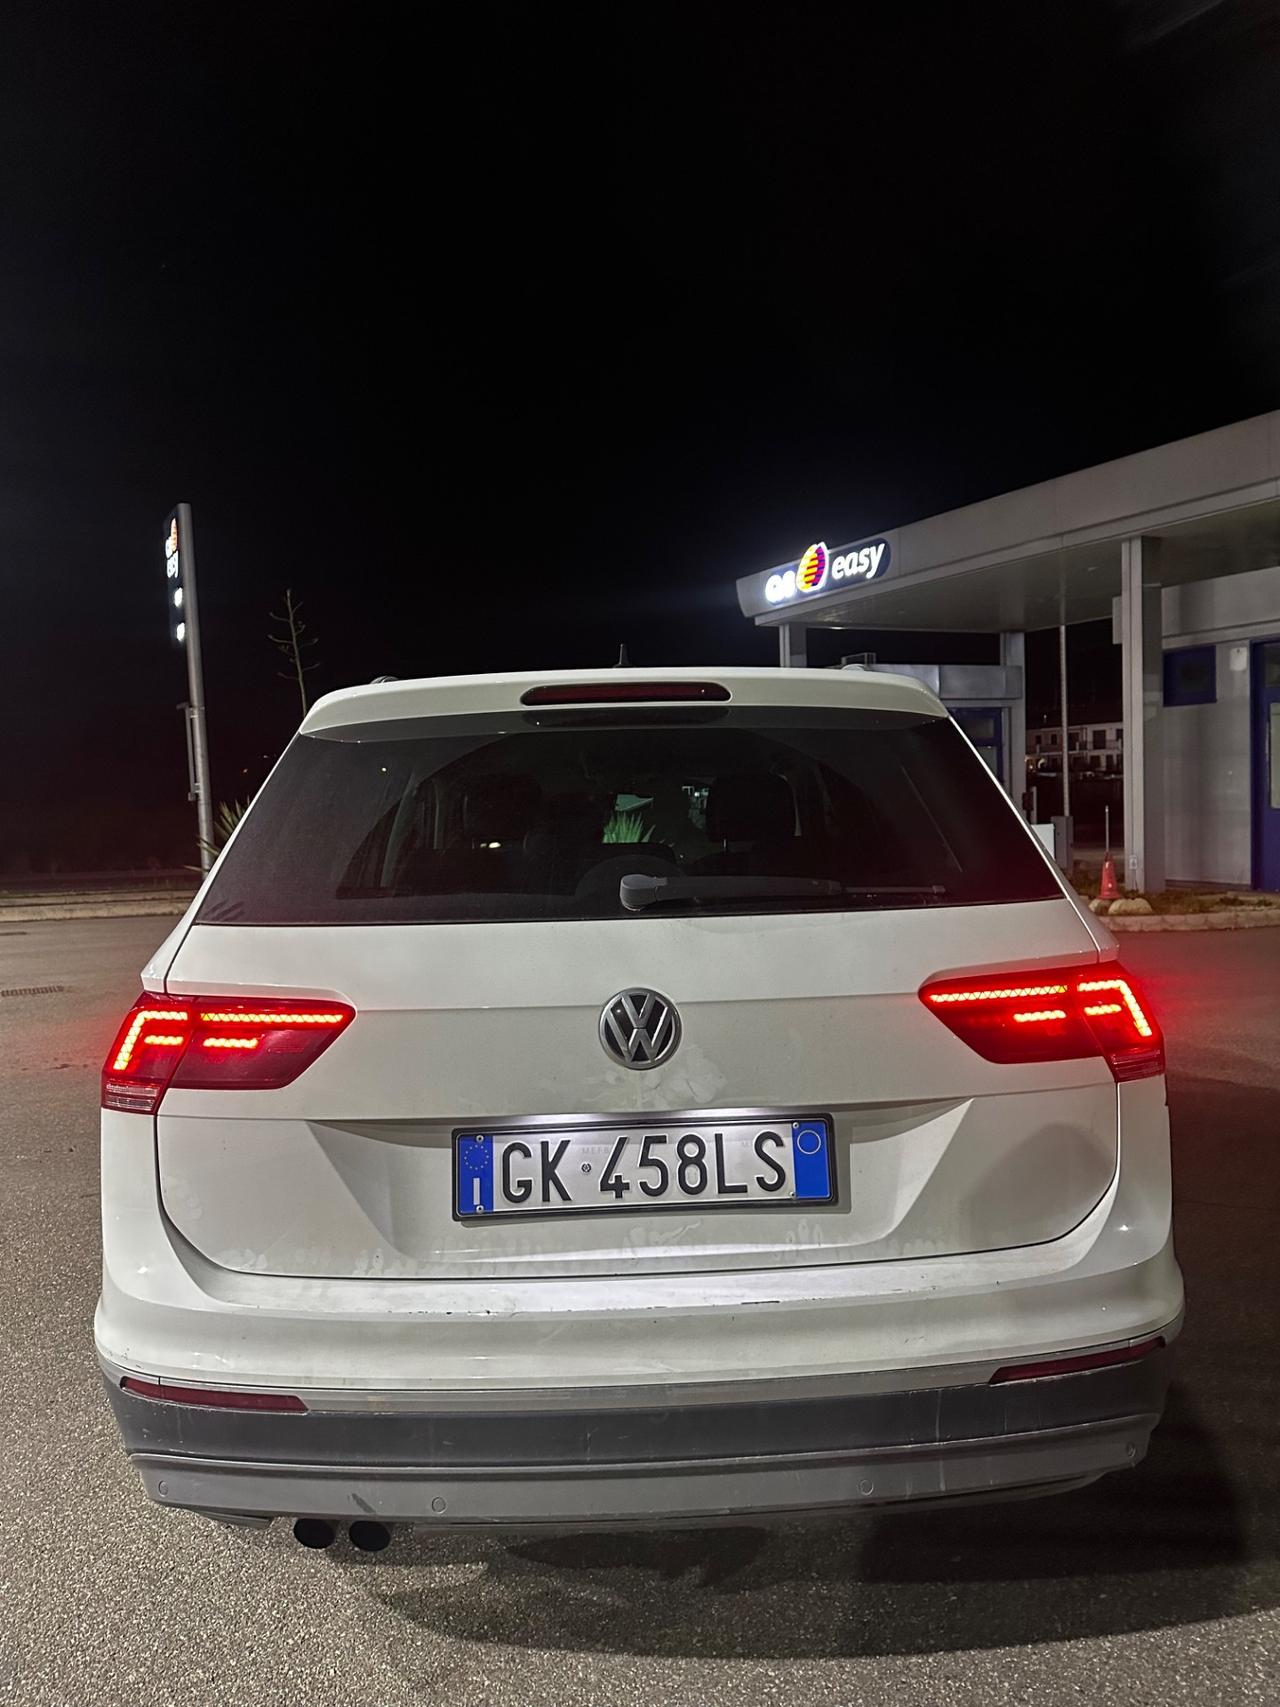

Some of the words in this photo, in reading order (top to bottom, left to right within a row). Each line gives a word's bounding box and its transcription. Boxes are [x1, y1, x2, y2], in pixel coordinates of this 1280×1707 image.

[831, 543, 886, 579] easy
[502, 1139, 572, 1204] GK
[599, 1131, 786, 1199] 458LS
